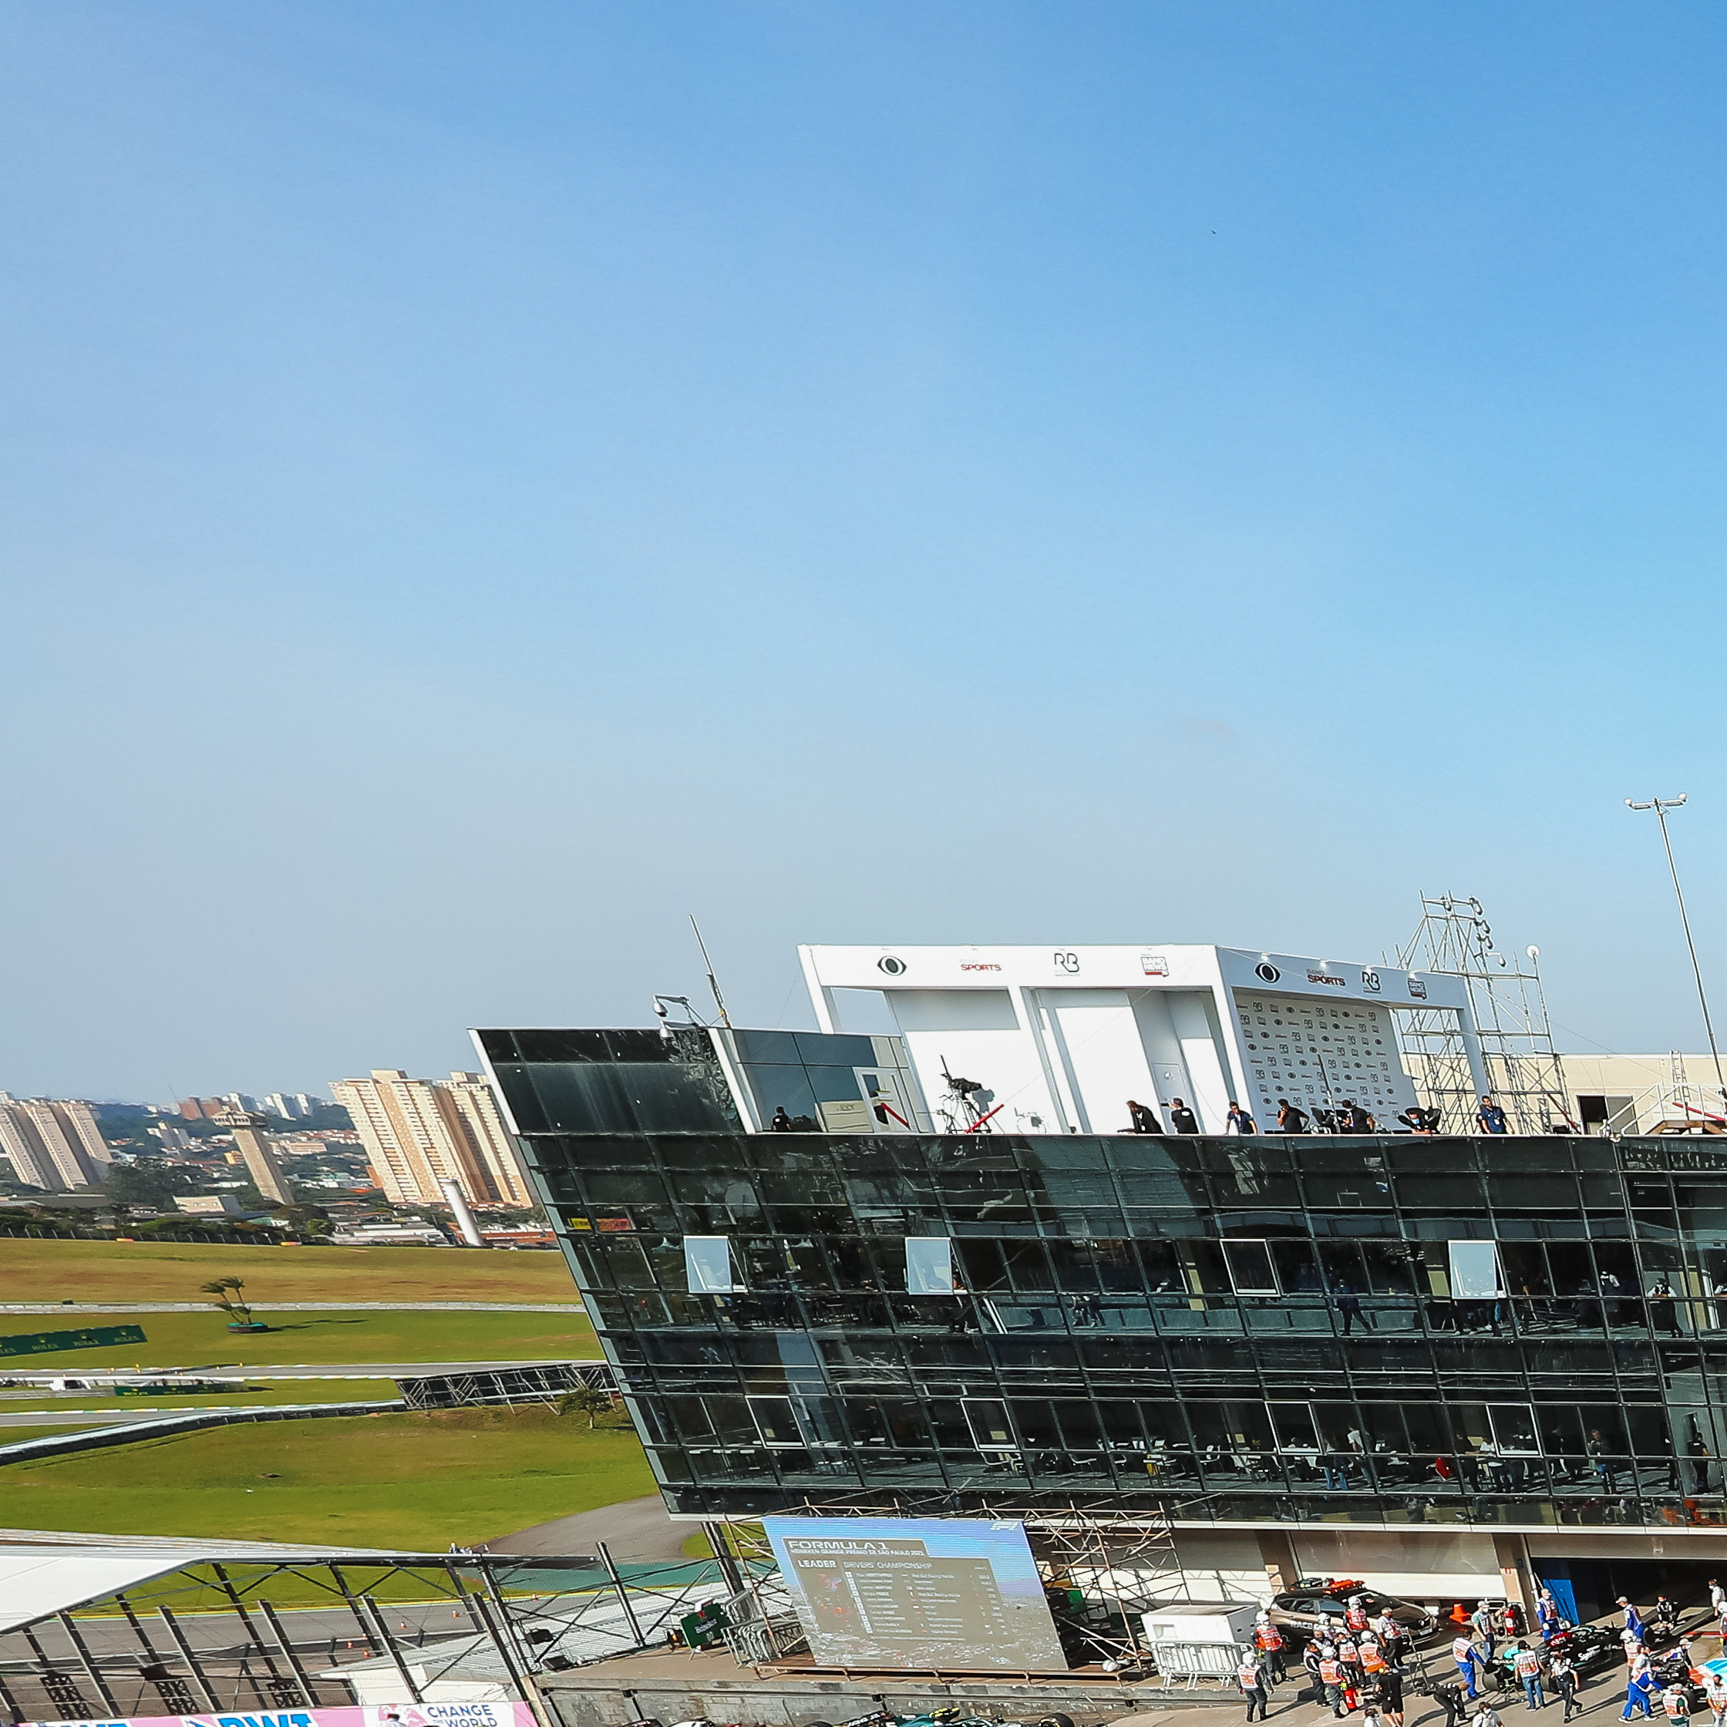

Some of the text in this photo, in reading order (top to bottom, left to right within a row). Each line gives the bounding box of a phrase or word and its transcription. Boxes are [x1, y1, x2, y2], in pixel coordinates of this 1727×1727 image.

[1307, 974, 1347, 987] SPORTS
[788, 1541, 875, 1549] FORMULA
[798, 1560, 837, 1568] LEADER
[1290, 1621, 1313, 1629] RACE
[427, 1704, 493, 1718] CHANGE
